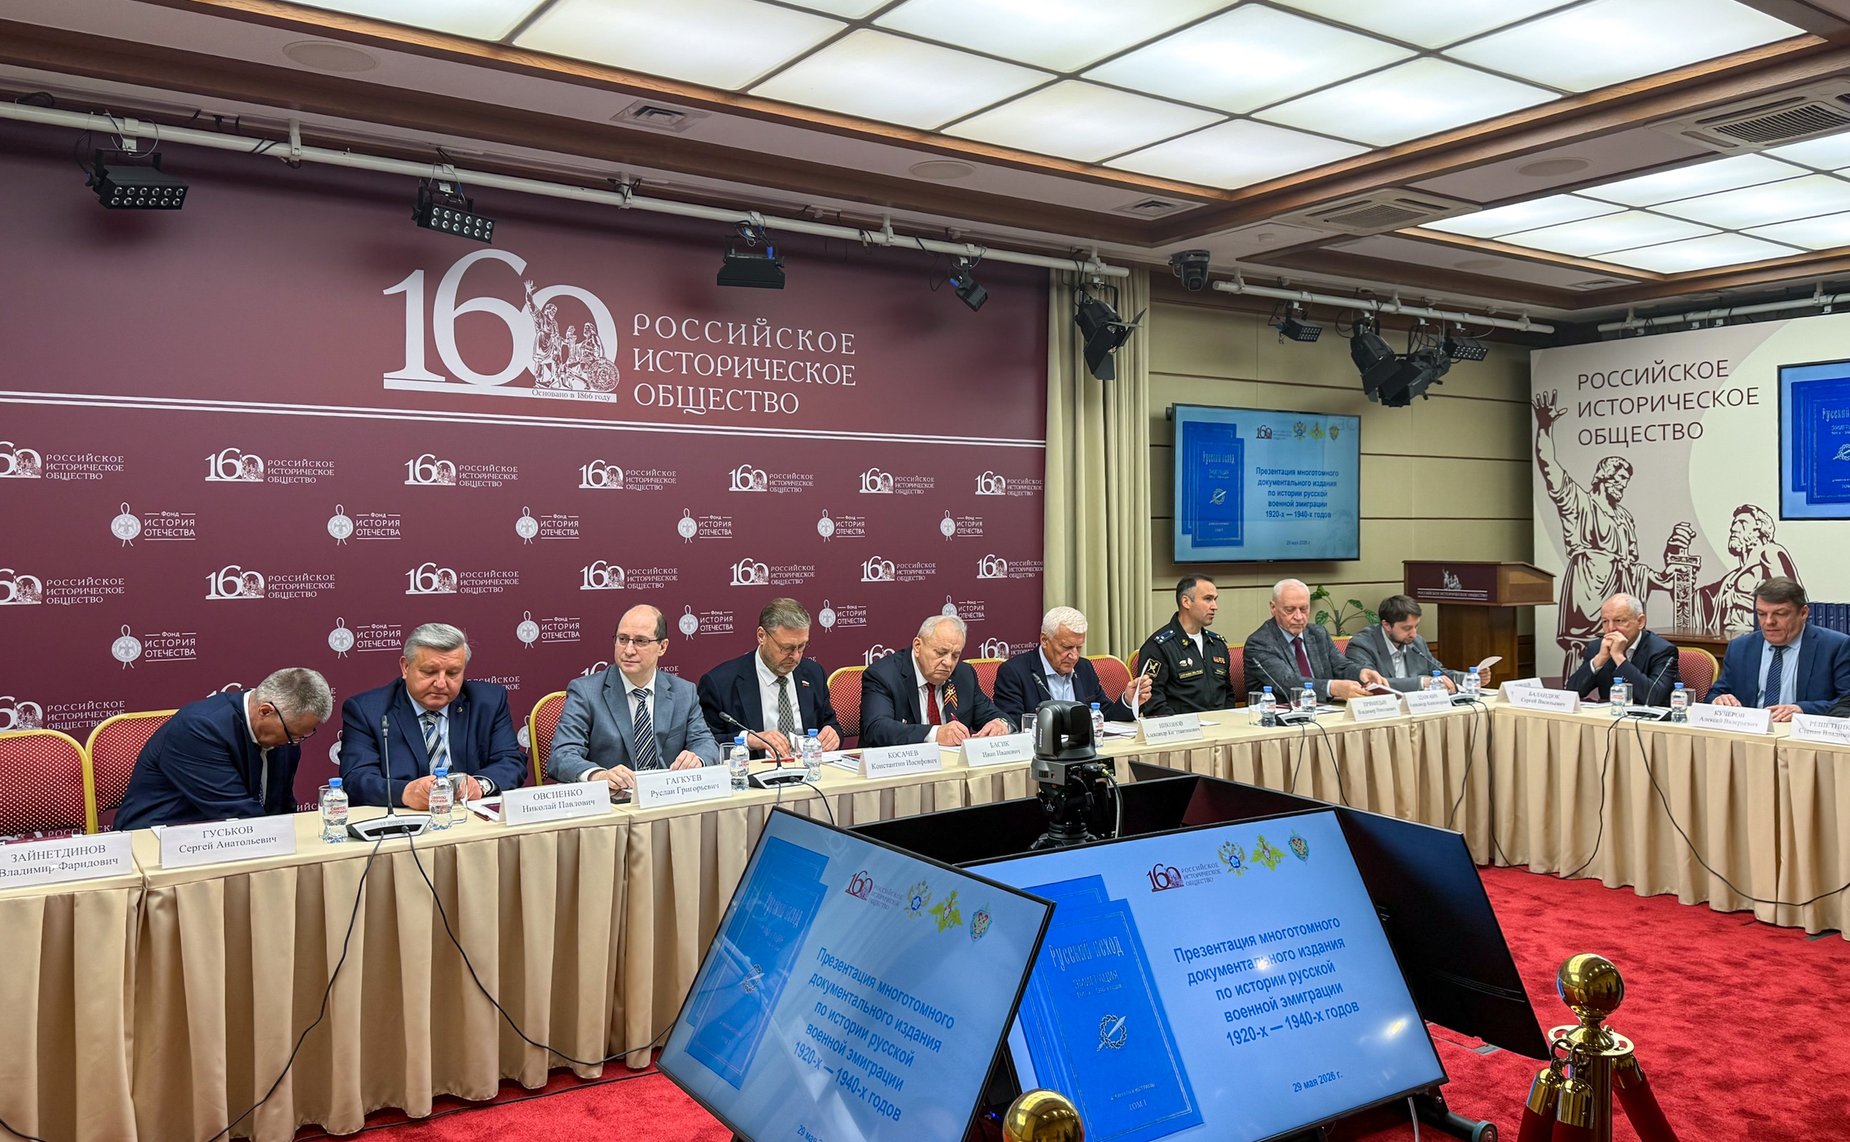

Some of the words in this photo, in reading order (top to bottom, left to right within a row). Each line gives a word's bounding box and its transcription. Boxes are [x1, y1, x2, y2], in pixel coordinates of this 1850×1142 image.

[383, 249, 619, 403] 160
[632, 313, 856, 355] РОССИЙСКОЕ
[633, 348, 856, 387] ИСТОРИЧЕСКОЕ
[1578, 359, 1729, 390] РОССИЙСКОЕ
[532, 390, 568, 398] Основано
[634, 383, 800, 415] ОБЩЕСТВО
[1578, 387, 1759, 418] ИСТОРИЧЕСКОЕ
[1578, 422, 1703, 448] ОБЩЕСТВО
[46, 454, 124, 463] РОССИЙСКОЕ
[204, 448, 264, 481] 160
[267, 459, 335, 468] РОССИЙСКОЕ
[46, 463, 124, 472] ИСТОРИЧЕСКОЕ
[267, 468, 334, 476] ИСТОРИЧЕСКОЕ
[404, 454, 456, 485] 160
[459, 464, 518, 473] РОССИЙСКОЕ
[626, 469, 676, 477] РОССИЙСКОЕ
[1256, 467, 1295, 476] Презентация
[1297, 469, 1339, 477] многотомного
[46, 472, 103, 481] ОБЩЕСТВО
[267, 476, 316, 484] ОБЩЕСТВО
[578, 460, 623, 489] 160
[728, 464, 767, 491] 160
[859, 468, 893, 494] 160
[459, 480, 502, 488] ОБЩЕСТВО
[975, 470, 1006, 495] 160
[1258, 479, 1311, 488] документального
[1304, 490, 1327, 498] русской
[1295, 501, 1327, 509] эмиграции
[161, 510, 179, 518] Фонд
[144, 519, 195, 527] ИСТОРИЯ
[144, 528, 196, 537] ОТЕЧЕСТВА
[730, 558, 768, 586] 160
[860, 556, 895, 582] 160
[976, 554, 1007, 579] 160
[268, 574, 335, 582] РОССИЙСКОЕ
[405, 562, 457, 594] 160
[460, 570, 519, 578] РОССИЙСКОЕ
[580, 560, 624, 590] 160
[46, 577, 125, 587] РОССИЙСКОЕ
[205, 565, 265, 600] 160
[268, 582, 335, 590] ИСТОРИЧЕСКОЕ
[460, 578, 519, 586] ИСТОРИЧЕСКОЕ
[627, 582, 664, 590] ОБЩЕСТВО
[46, 587, 124, 596] ИСТОРИЧЕСКОЕ
[268, 590, 317, 599] ОБЩЕСТВО
[460, 586, 503, 594] ОБЩЕСТВО
[46, 596, 103, 606] ОБЩЕСТВО
[542, 622, 580, 630] ИСТОРИЯ
[837, 617, 867, 625] ОТЕЧЕСТВА
[357, 630, 401, 638] ИСТОРИЯ
[542, 631, 580, 639] ОТЕЧЕСТВА
[145, 638, 196, 647] ИСТОРИЯ
[357, 639, 401, 647] ОТЕЧЕСТВА
[145, 648, 196, 657] ОТЕЧЕСТВА
[887, 749, 918, 759] КОСАЧЕВ
[665, 773, 702, 784] ГАГКУЕВ
[533, 788, 583, 801] ОВСИЕНКО
[650, 786, 674, 799] Руслан
[676, 782, 720, 796] Григорьевич
[522, 801, 556, 813] Николай
[558, 799, 595, 810] Павлович
[202, 824, 255, 840] ГУСЬКОВ
[178, 838, 213, 855] Сергей
[216, 834, 277, 851] Анатольевич
[11, 844, 106, 863] ЗАЙНЕТДИНОВ
[59, 858, 118, 871] Фаридович
[1147, 864, 1184, 892] 160
[845, 870, 873, 901] 160
[1174, 934, 1257, 964] Презентация
[1260, 916, 1341, 946] многотомного
[1298, 938, 1346, 959] издания
[1216, 986, 1232, 1002] по
[1234, 975, 1286, 996] истории
[1288, 960, 1336, 985] русской
[816, 946, 876, 990] Презентация
[877, 979, 955, 1030] многотомного
[1224, 1001, 1278, 1023] военной
[1281, 982, 1343, 1010] эмиграции
[808, 973, 894, 1026] документального
[897, 1018, 942, 1054] издания
[1226, 1025, 1269, 1048] 1920-х
[1284, 1011, 1324, 1035] 1940-х
[1326, 1000, 1359, 1023] годов
[814, 1002, 826, 1017] по
[827, 1008, 868, 1036] истории
[869, 1032, 914, 1067] русской
[806, 1022, 848, 1055] военной
[846, 1047, 904, 1091] эмиграции
[794, 1042, 822, 1071] 1920-х
[836, 1068, 868, 1100] 1940-х
[868, 1091, 902, 1122] годов
[1292, 1081, 1302, 1093] 29
[1304, 1079, 1319, 1090] мая
[1320, 1073, 1336, 1087] 2026
